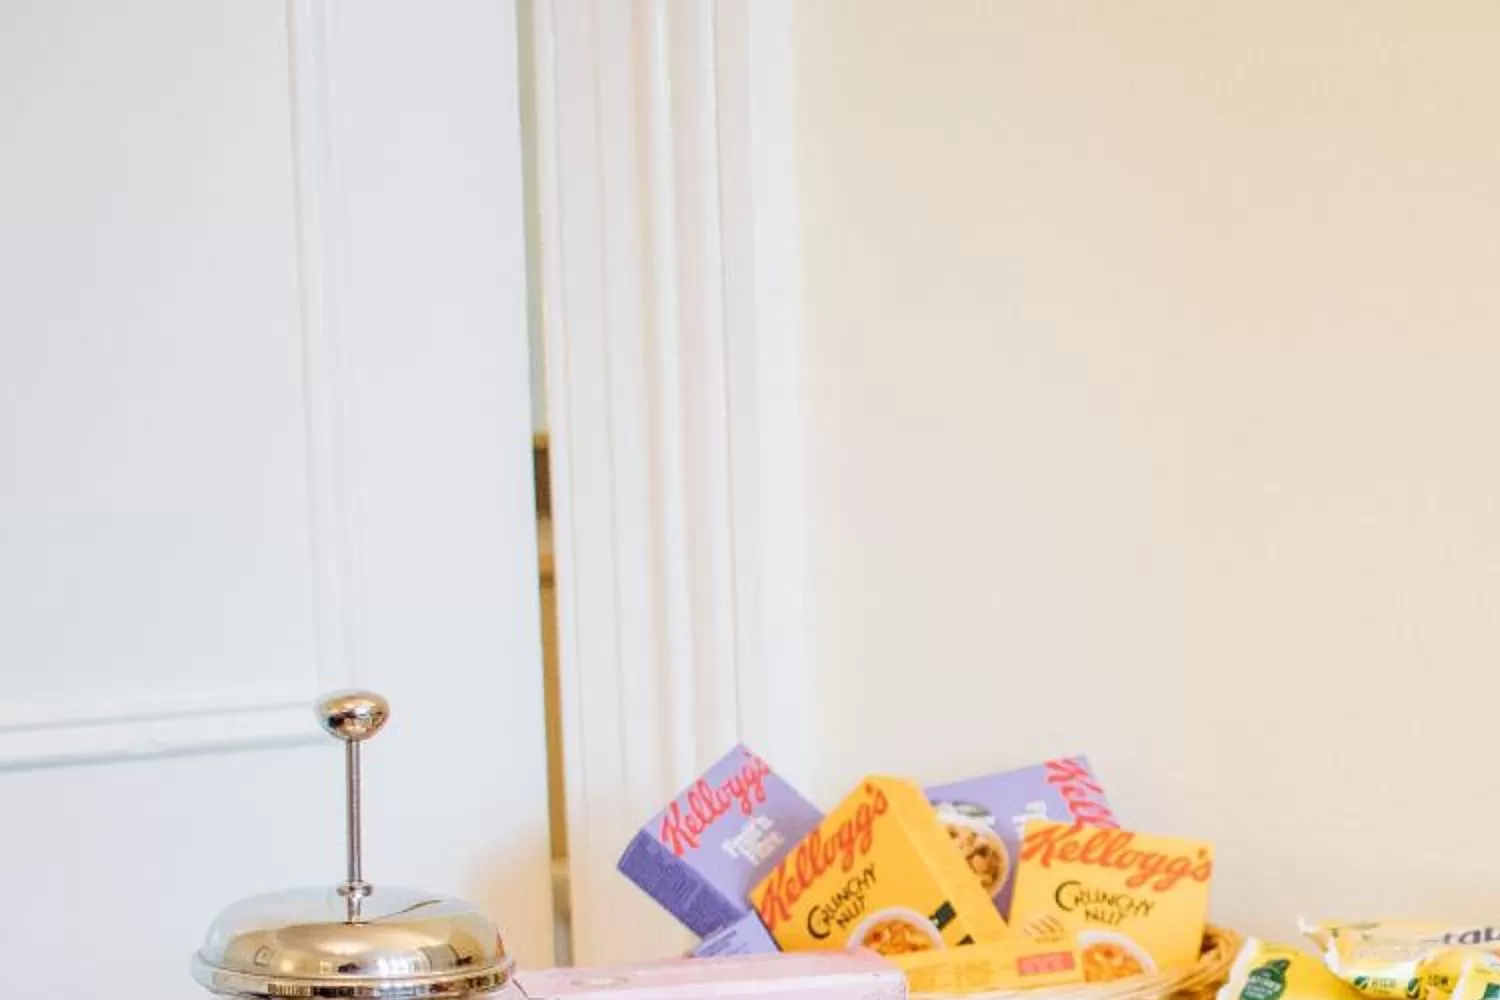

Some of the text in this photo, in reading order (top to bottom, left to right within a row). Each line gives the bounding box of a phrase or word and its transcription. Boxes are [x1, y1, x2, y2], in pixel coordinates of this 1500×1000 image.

[659, 751, 771, 857] Kellogg's
[760, 783, 889, 930] Kellogg's
[1019, 820, 1214, 893] Kellogg's
[808, 862, 877, 939] CRUNCHY
[836, 895, 865, 931] NUT
[1054, 880, 1156, 917] CRUNCHY
[1084, 907, 1127, 926] NUT
